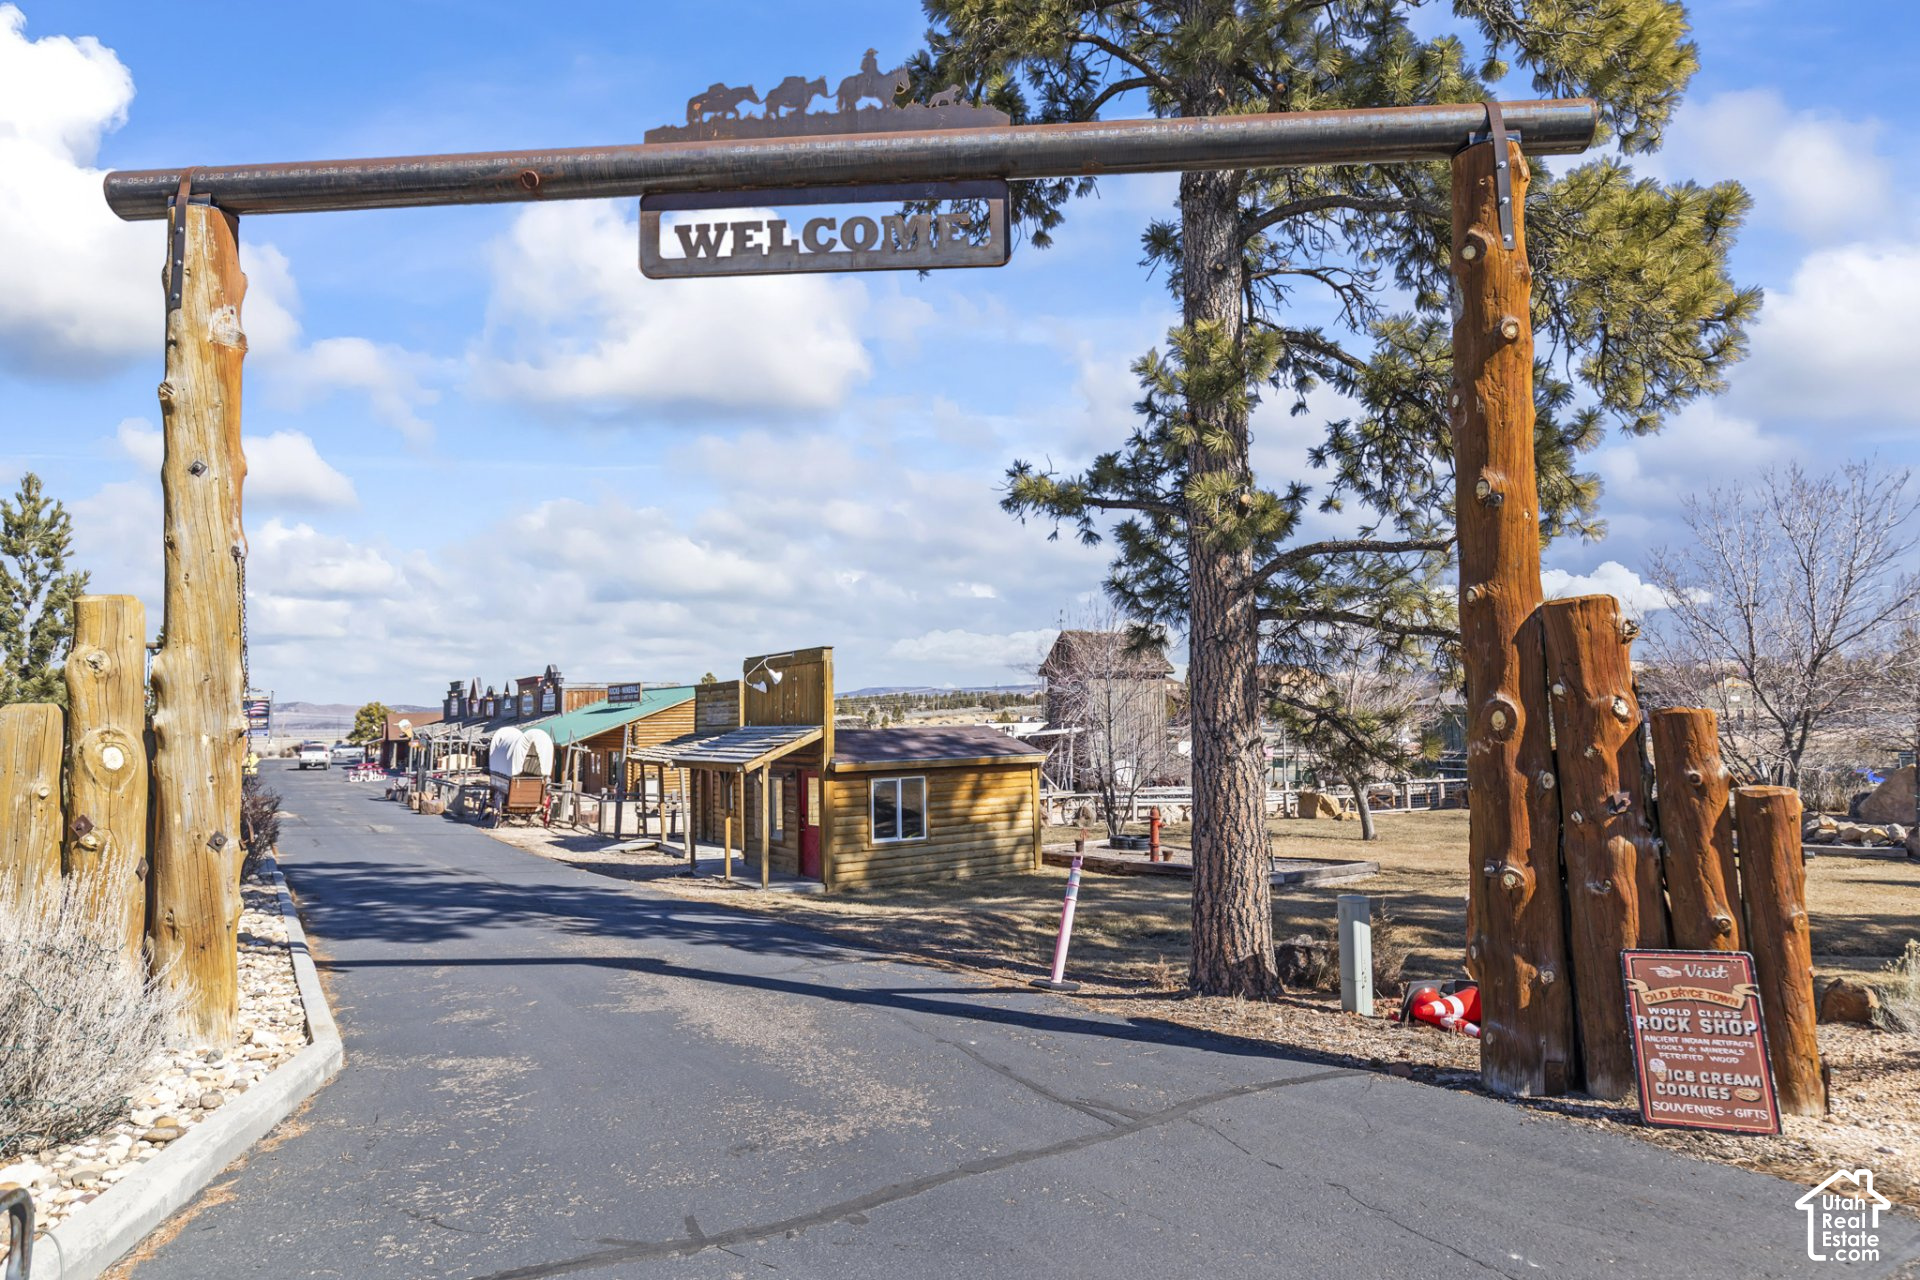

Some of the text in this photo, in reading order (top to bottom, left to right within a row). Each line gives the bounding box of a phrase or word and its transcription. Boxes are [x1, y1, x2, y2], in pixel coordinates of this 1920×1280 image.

[674, 212, 971, 259] WELCOME
[1682, 964, 1729, 979] Visit
[1644, 988, 1739, 1006] OLD BRYCE TOWN
[1648, 1007, 1742, 1019] WORLD CLASS
[1636, 1015, 1758, 1036] ROCK SHOP
[1643, 1035, 1755, 1048] ANCIENT INDIAN ARTIFACTS
[1654, 1044, 1684, 1052] ROCKS
[1700, 1046, 1745, 1056] MINERALS
[1658, 1052, 1740, 1064] PETRIFIED WOOD
[1667, 1068, 1762, 1088] ICE CREAM
[1655, 1082, 1732, 1100] COOKIES
[1652, 1100, 1725, 1117] SOUVENIRS
[1734, 1108, 1769, 1120] GIFTS
